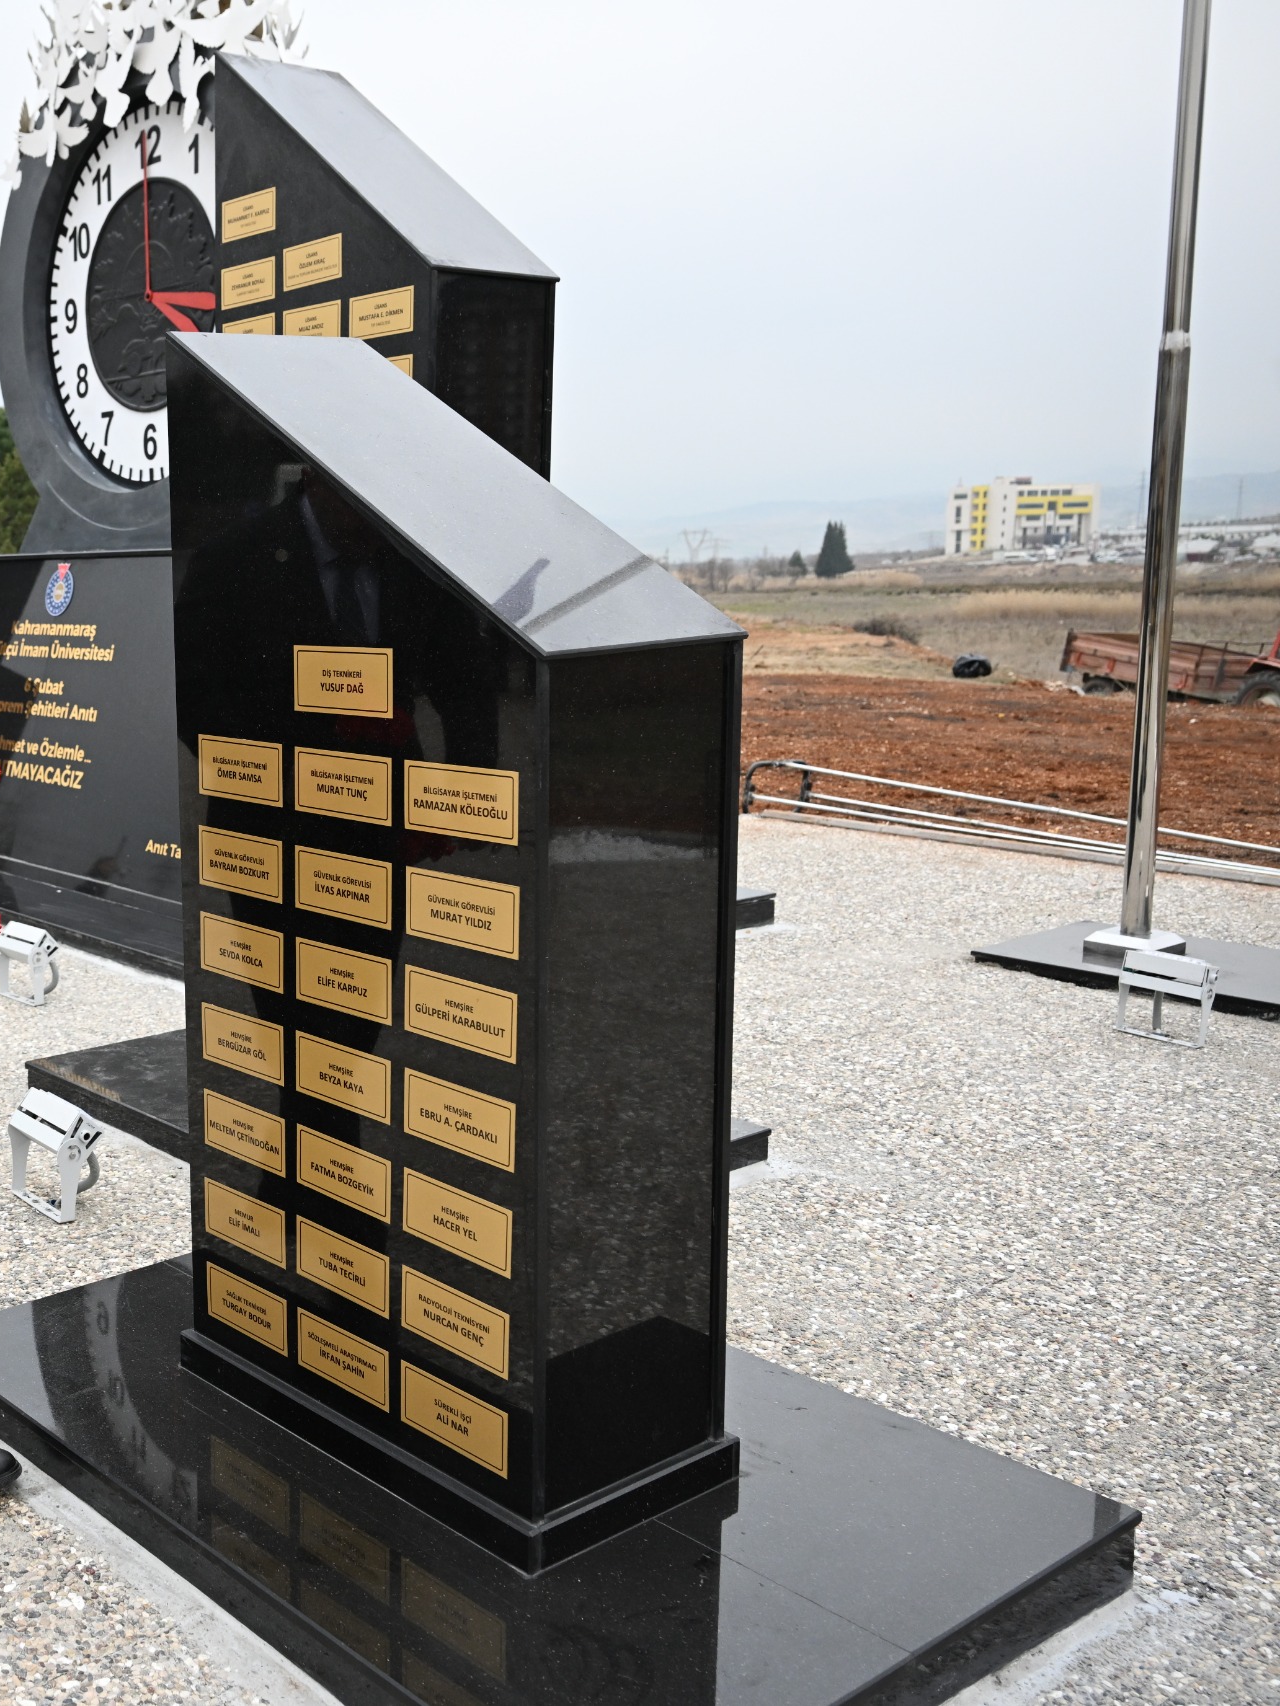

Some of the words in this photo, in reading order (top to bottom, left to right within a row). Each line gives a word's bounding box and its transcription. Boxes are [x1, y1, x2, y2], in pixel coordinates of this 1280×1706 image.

[135, 125, 161, 169] 12
[189, 134, 200, 174] 1
[93, 165, 112, 205] 11
[69, 223, 90, 261] 10
[65, 299, 78, 333] 9
[77, 364, 88, 398] 8
[101, 411, 115, 446] 7
[143, 423, 158, 460] 6
[11, 619, 97, 641] Kahramanmaraş
[19, 638, 50, 658] İmam
[50, 640, 115, 662] Üniversitesi
[322, 668, 331, 678] DİŞ
[332, 669, 362, 678] TEKNİKERİ
[24, 677, 33, 693] 6
[32, 678, 65, 697] Şubat
[320, 682, 344, 692] YUSUF
[346, 682, 364, 694] DAĞ
[24, 700, 70, 720] Şehitleri
[69, 704, 98, 722] Anıtı
[26, 742, 40, 755] ve
[217, 767, 237, 779] ÖMER
[238, 772, 262, 783] SAMSA
[310, 769, 342, 781] BİLGİSAYAR
[343, 773, 374, 785] İŞLETMENİ
[316, 783, 344, 795] MURAT
[346, 787, 367, 801] TUNÇ
[423, 785, 460, 797] BİLGİSAYAR
[462, 790, 497, 802] İŞLETMENİ
[413, 798, 457, 813] RAMAZAN
[459, 803, 508, 820] KÖLEOĞLU
[145, 839, 169, 856] Anıt
[209, 859, 237, 873] BAYRAM
[238, 866, 269, 880] BOZKURT
[313, 870, 341, 882] GÜVENLİK
[341, 876, 371, 889] GÖREVLİSİ
[314, 881, 334, 895] İLYAS
[335, 888, 370, 903] AKPINAR
[427, 894, 459, 908] GÜVENLİK
[461, 901, 495, 915] GÖREVLİSİ
[430, 908, 462, 923] MURAT
[464, 916, 491, 931] YILDIZ
[219, 947, 240, 961] SEVDA
[241, 954, 263, 968] KOLCA
[329, 967, 354, 980] HEMŞİRE
[317, 975, 335, 988] ELİFE
[337, 981, 367, 997] KARPUZ
[444, 999, 473, 1013] HEMŞİRE
[415, 1003, 450, 1021] GÜLPERİ
[452, 1014, 505, 1037] KARABULUT
[217, 1037, 251, 1055] BERGÜZAR
[252, 1049, 266, 1061] GÖL
[328, 1063, 353, 1077] HEMŞİRE
[319, 1071, 341, 1087] BEYZA
[343, 1080, 364, 1094] KAYA
[443, 1104, 472, 1120] HEMŞİRE
[419, 1107, 441, 1123] EBRU
[443, 1116, 452, 1127] A.
[454, 1120, 497, 1144] ÇARDAKLI
[209, 1119, 235, 1137] MELTEM
[236, 1131, 279, 1155] ÇETİNDOĞAN
[329, 1158, 354, 1174] HEMŞİRE
[310, 1161, 336, 1180] FATMA
[337, 1173, 374, 1196] BOZGEYİK
[228, 1216, 240, 1227] ELİF
[441, 1206, 469, 1223] HEMŞİRE
[433, 1214, 460, 1234] HACER
[462, 1227, 477, 1241] YEL
[329, 1251, 353, 1268] HEMŞİRE
[318, 1256, 338, 1273] TUBA
[339, 1267, 365, 1287] TECİRLİ
[222, 1297, 247, 1316] TURGAY
[248, 1312, 271, 1330] BODUR
[243, 1298, 266, 1315] TEKNİKERİ
[418, 1293, 452, 1315] RADYOLOJİ
[453, 1310, 490, 1334] TEKNİSYENİ
[423, 1308, 458, 1333] NURCAN
[460, 1327, 484, 1347] GENÇ
[307, 1331, 338, 1352] SÖZLEŞMELİ
[339, 1348, 377, 1372] ARAŞTIRMACI
[319, 1346, 340, 1366] İRFAN
[342, 1360, 364, 1379] ŞAHİN
[434, 1398, 458, 1417] SÜREKLİ
[460, 1411, 472, 1424] İŞÇİ
[436, 1412, 449, 1425] ALİ
[451, 1419, 468, 1436] NAR
